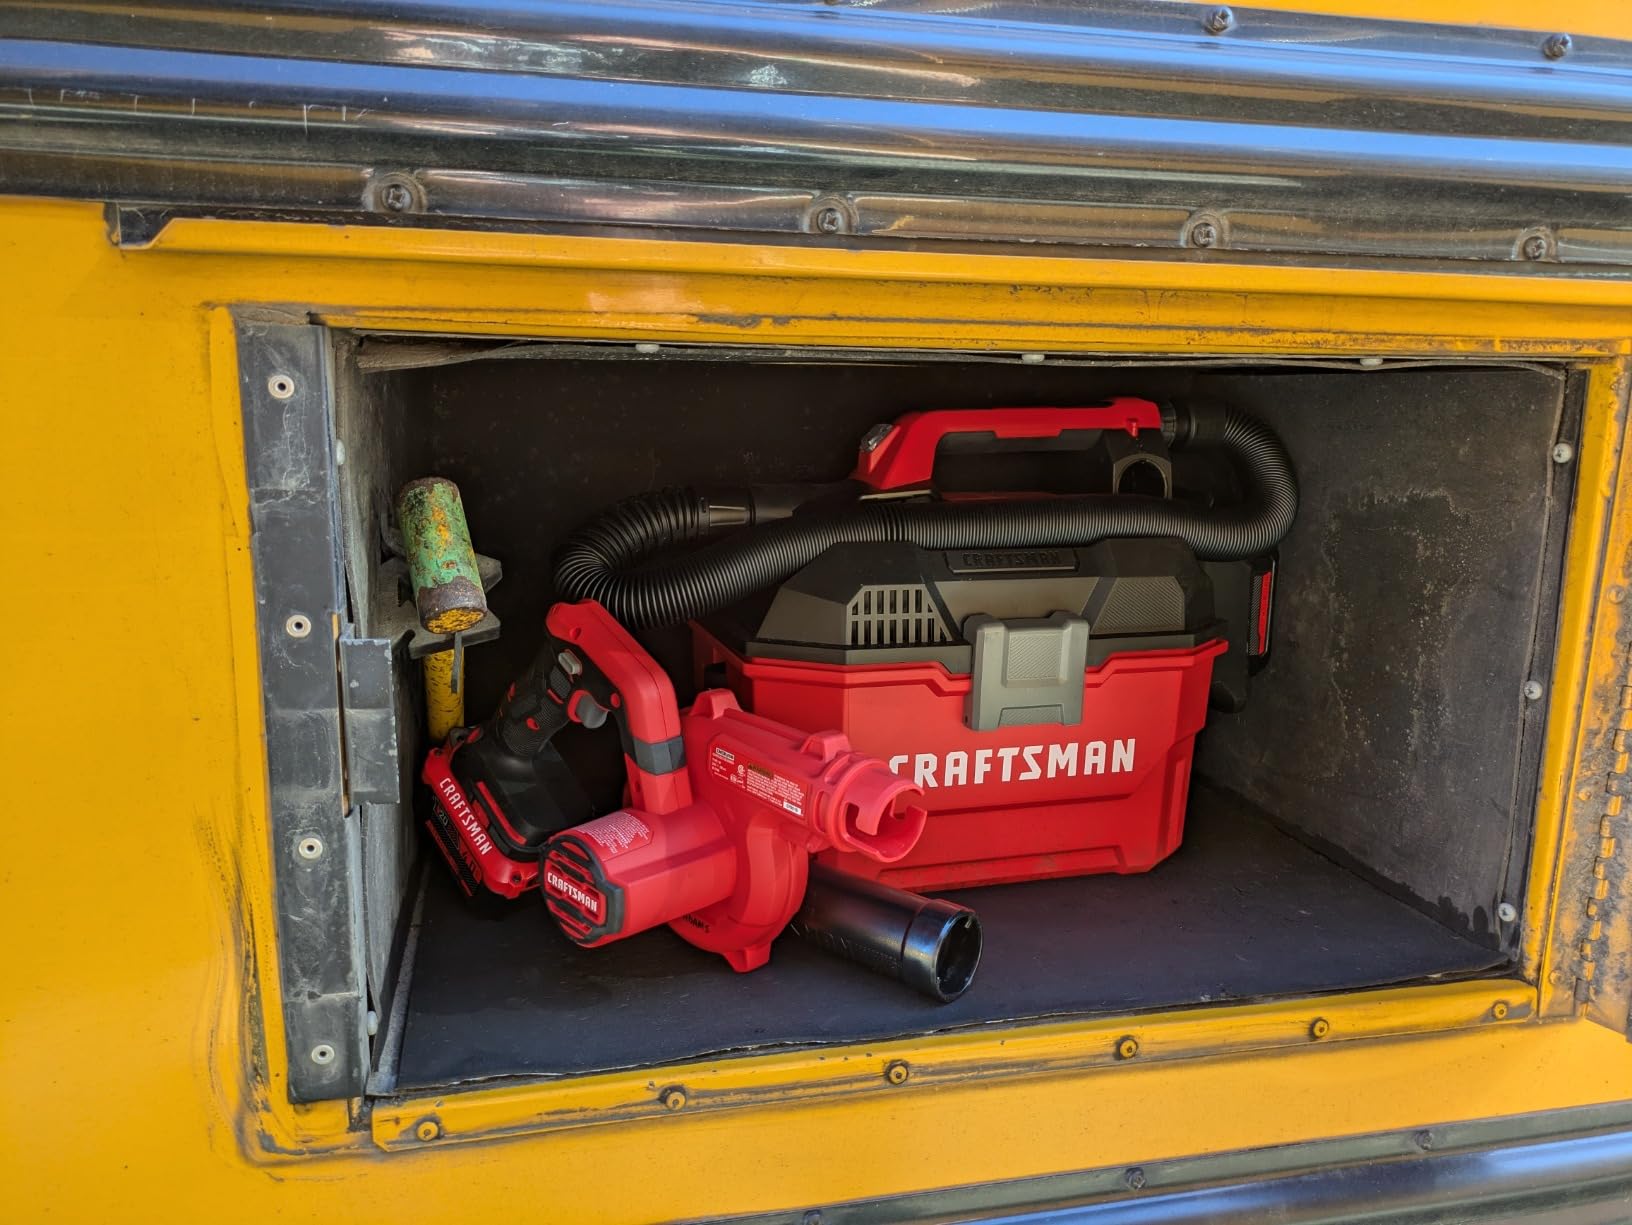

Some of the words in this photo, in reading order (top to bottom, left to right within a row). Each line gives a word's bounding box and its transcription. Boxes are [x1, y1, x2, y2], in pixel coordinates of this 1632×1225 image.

[961, 550, 1063, 568] CRAFTSMAN
[440, 778, 492, 855] CRAFTSMAN
[547, 872, 598, 912] CRAFTSMAN
